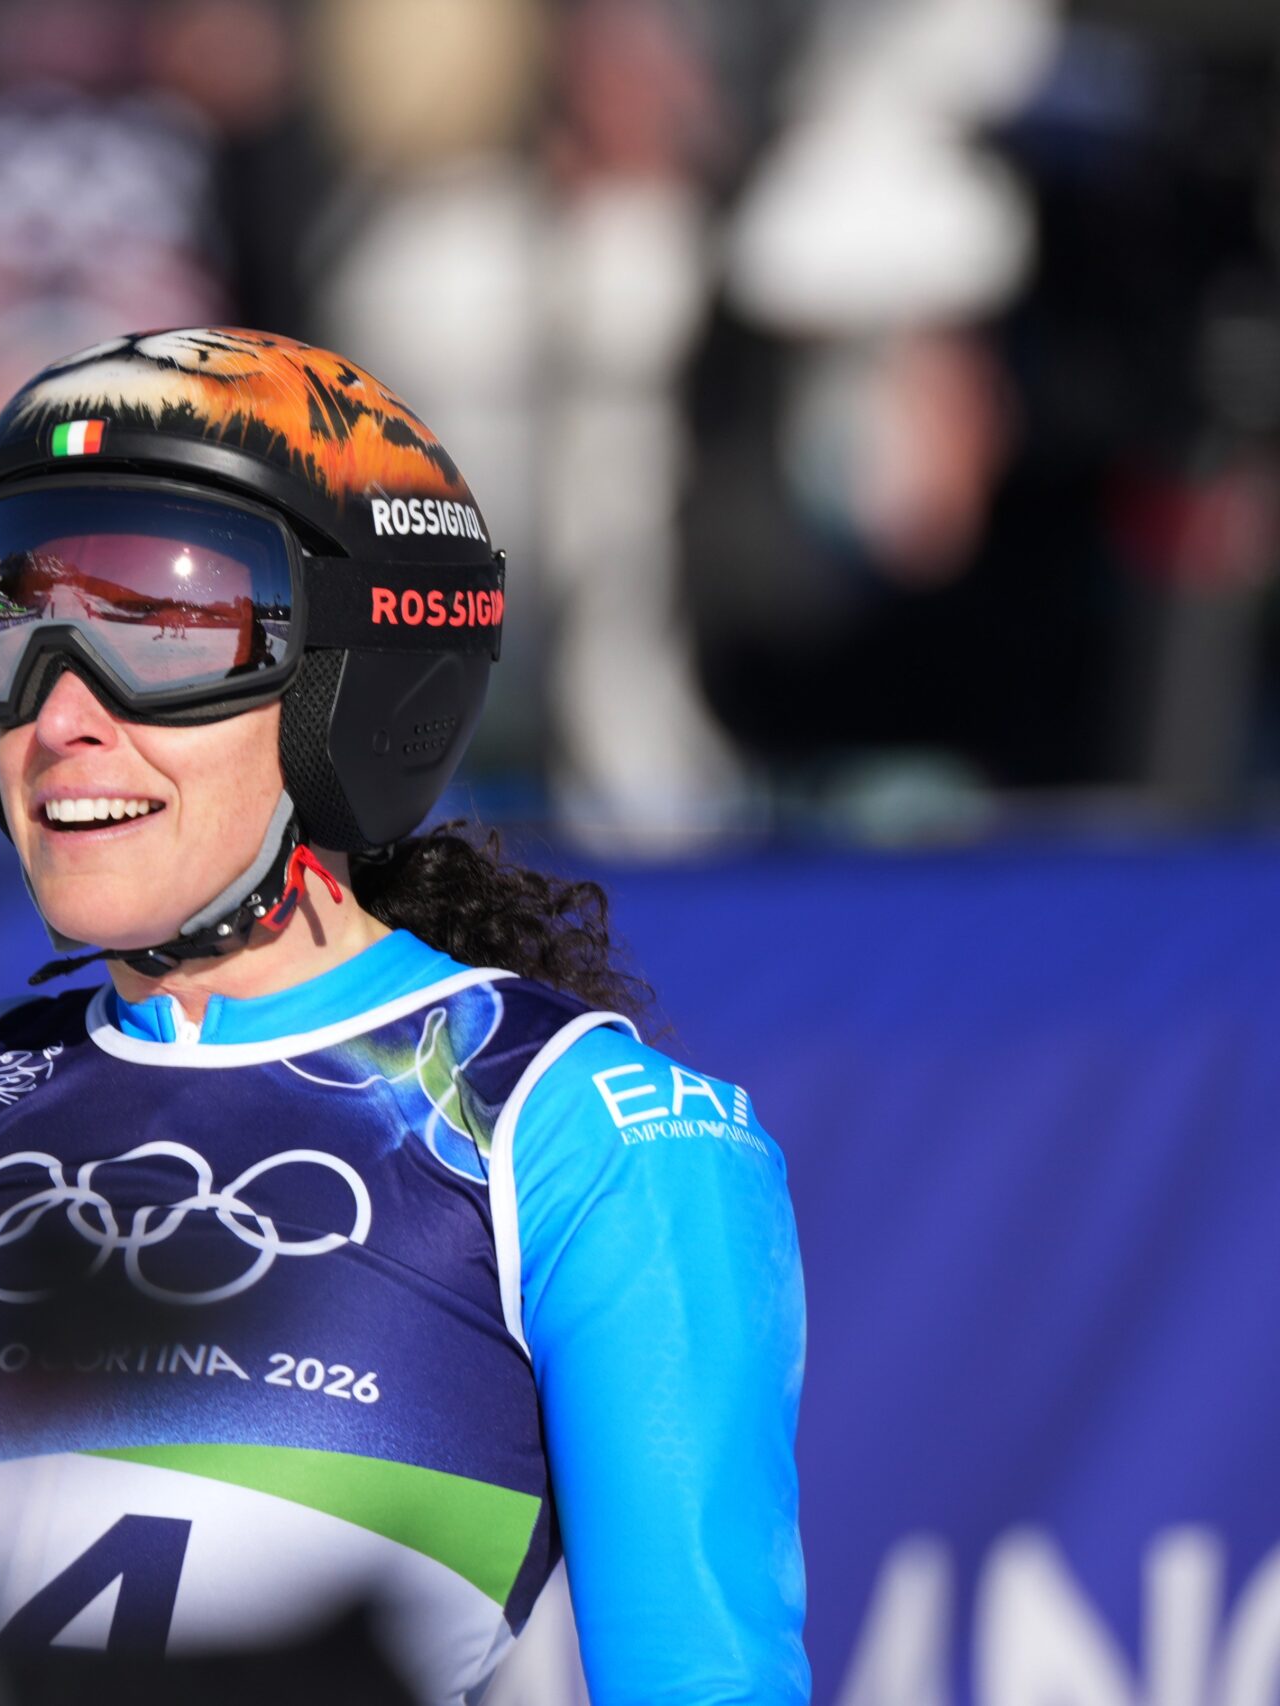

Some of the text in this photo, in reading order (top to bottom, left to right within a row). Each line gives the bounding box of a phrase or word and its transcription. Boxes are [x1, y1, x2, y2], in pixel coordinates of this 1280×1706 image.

[372, 498, 487, 543] ROSSIGNOL
[621, 1120, 704, 1146] EMPORIO
[264, 1353, 380, 1404] 2026
